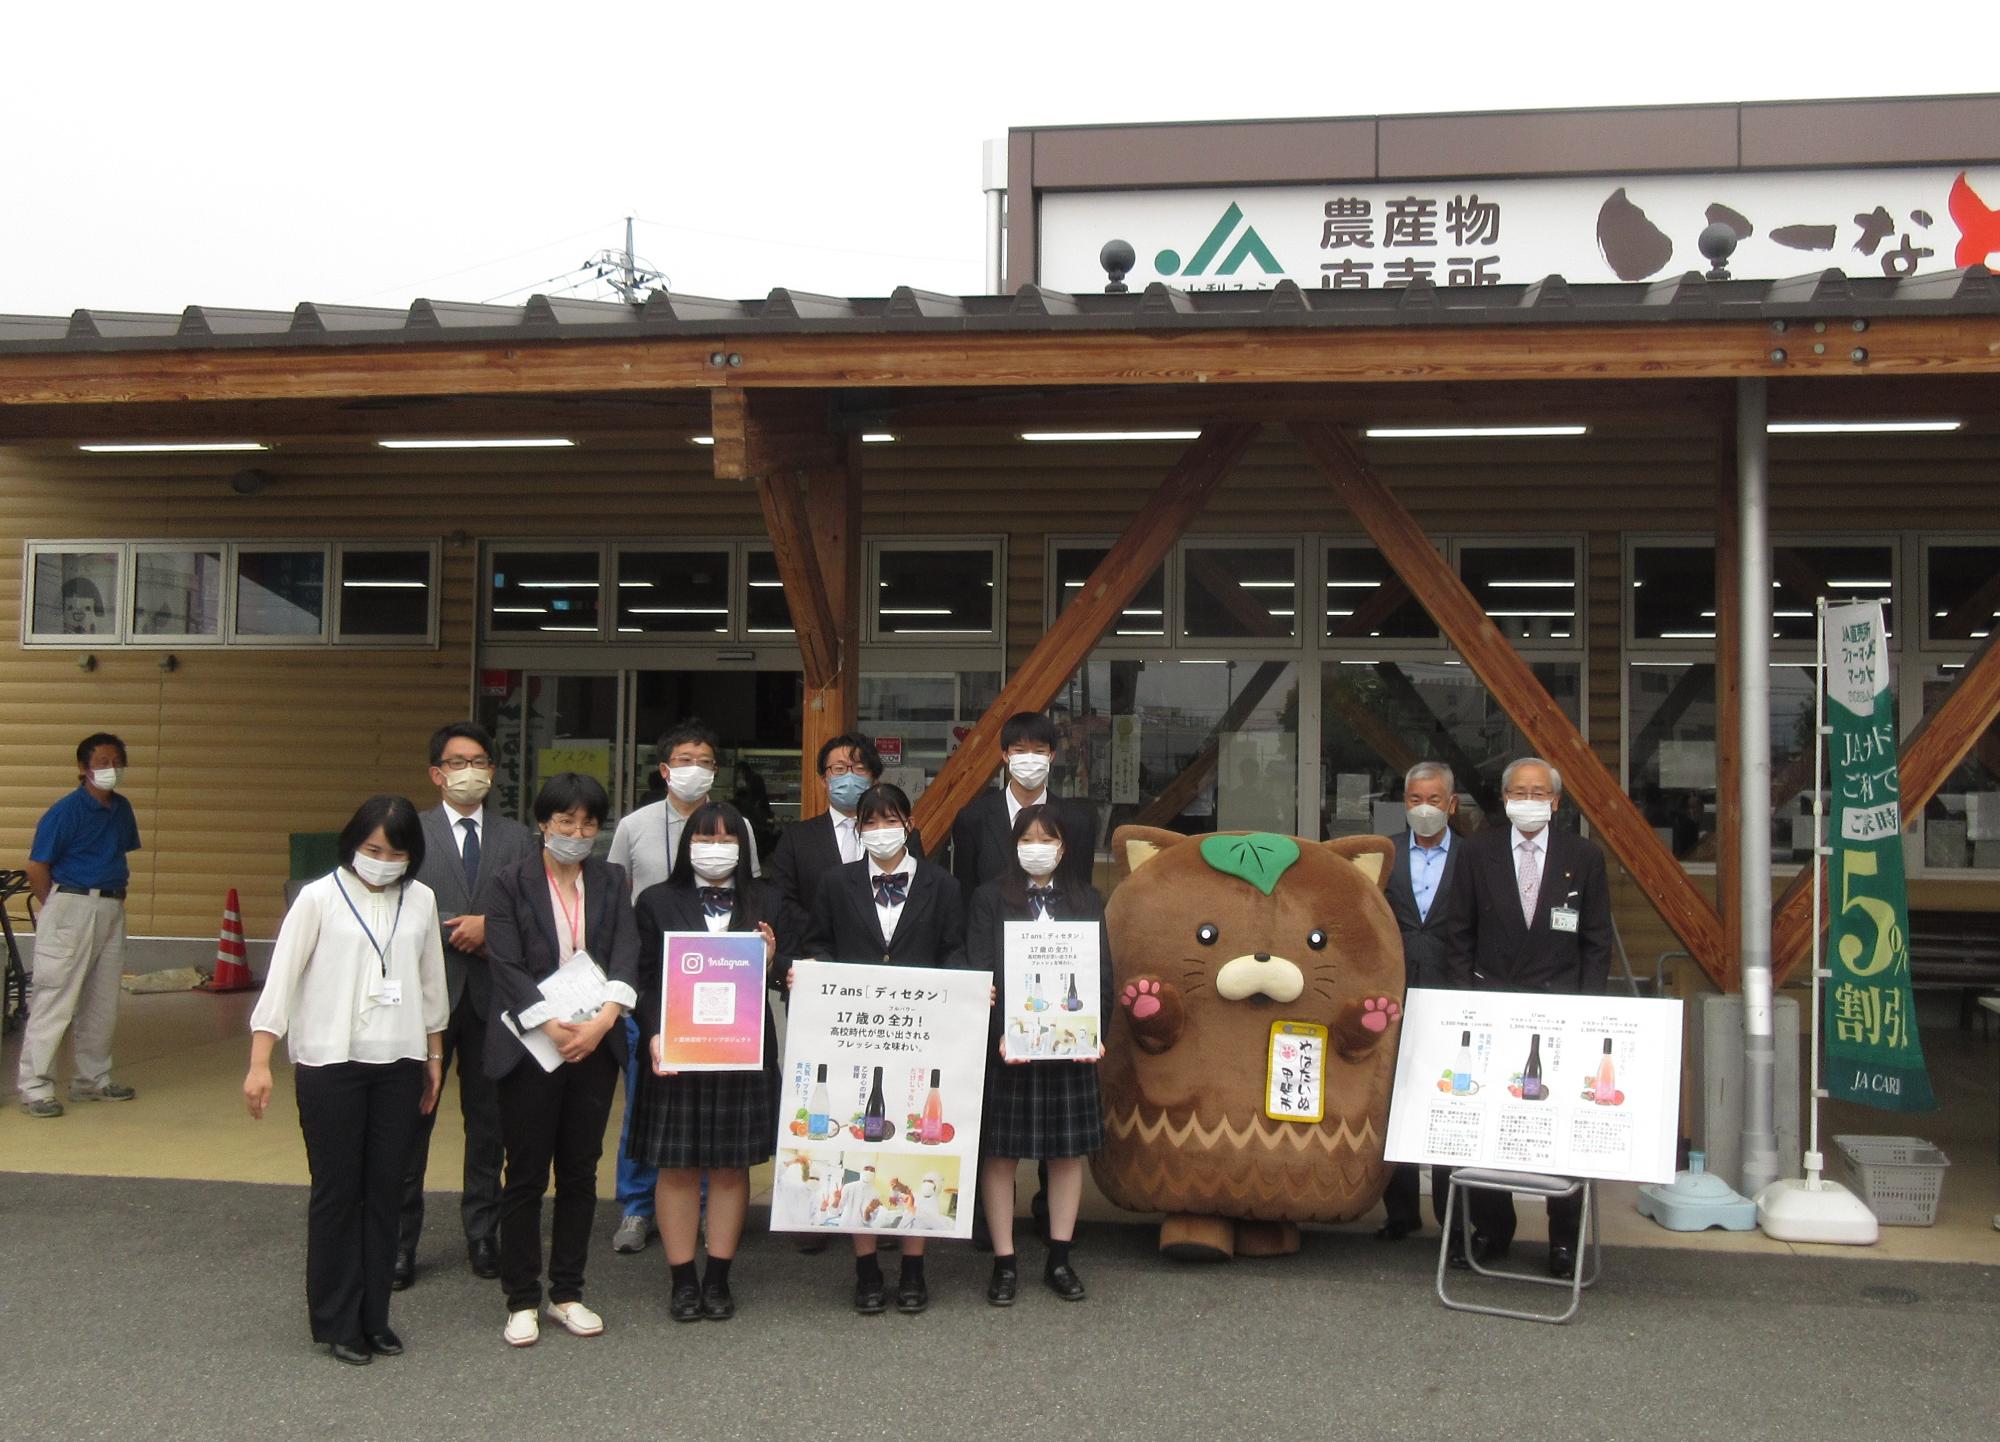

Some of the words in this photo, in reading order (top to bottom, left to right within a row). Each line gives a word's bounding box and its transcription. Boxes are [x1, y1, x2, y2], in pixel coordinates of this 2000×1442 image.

[1320, 194, 1502, 249] 農産物
[1843, 766, 1898, 803] ご利で
[708, 957, 750, 970] Instagram
[821, 983, 838, 996] 17
[839, 986, 863, 997] ans
[1835, 982, 1909, 1049] 割引
[830, 1026, 930, 1041] 高校時代が思い出される
[1850, 1070, 1869, 1091] JA
